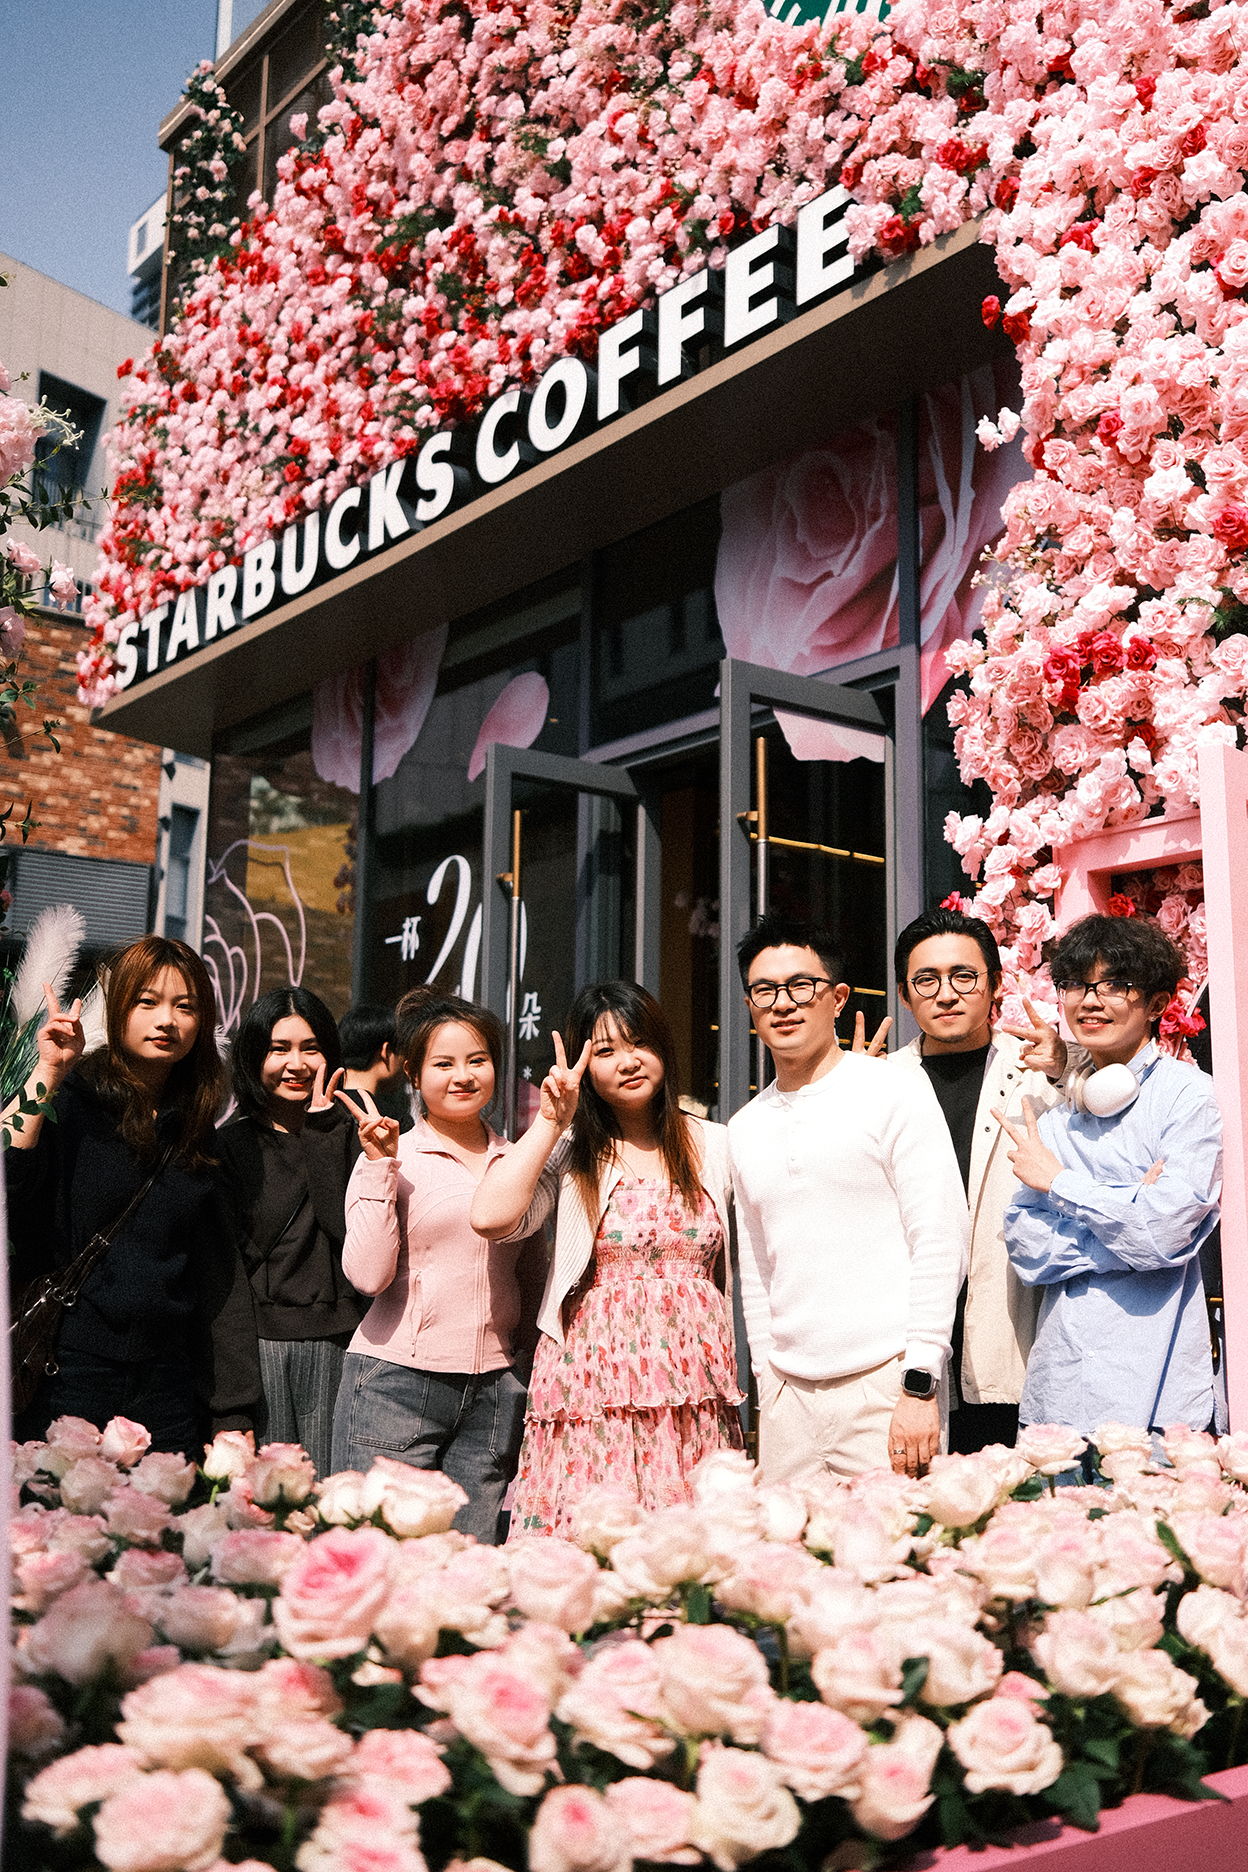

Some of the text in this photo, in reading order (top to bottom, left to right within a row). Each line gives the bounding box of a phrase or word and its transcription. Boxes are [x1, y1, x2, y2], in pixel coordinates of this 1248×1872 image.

[115, 183, 856, 689] STARBUCKS COFFEE
[518, 991, 542, 1041] 朵
